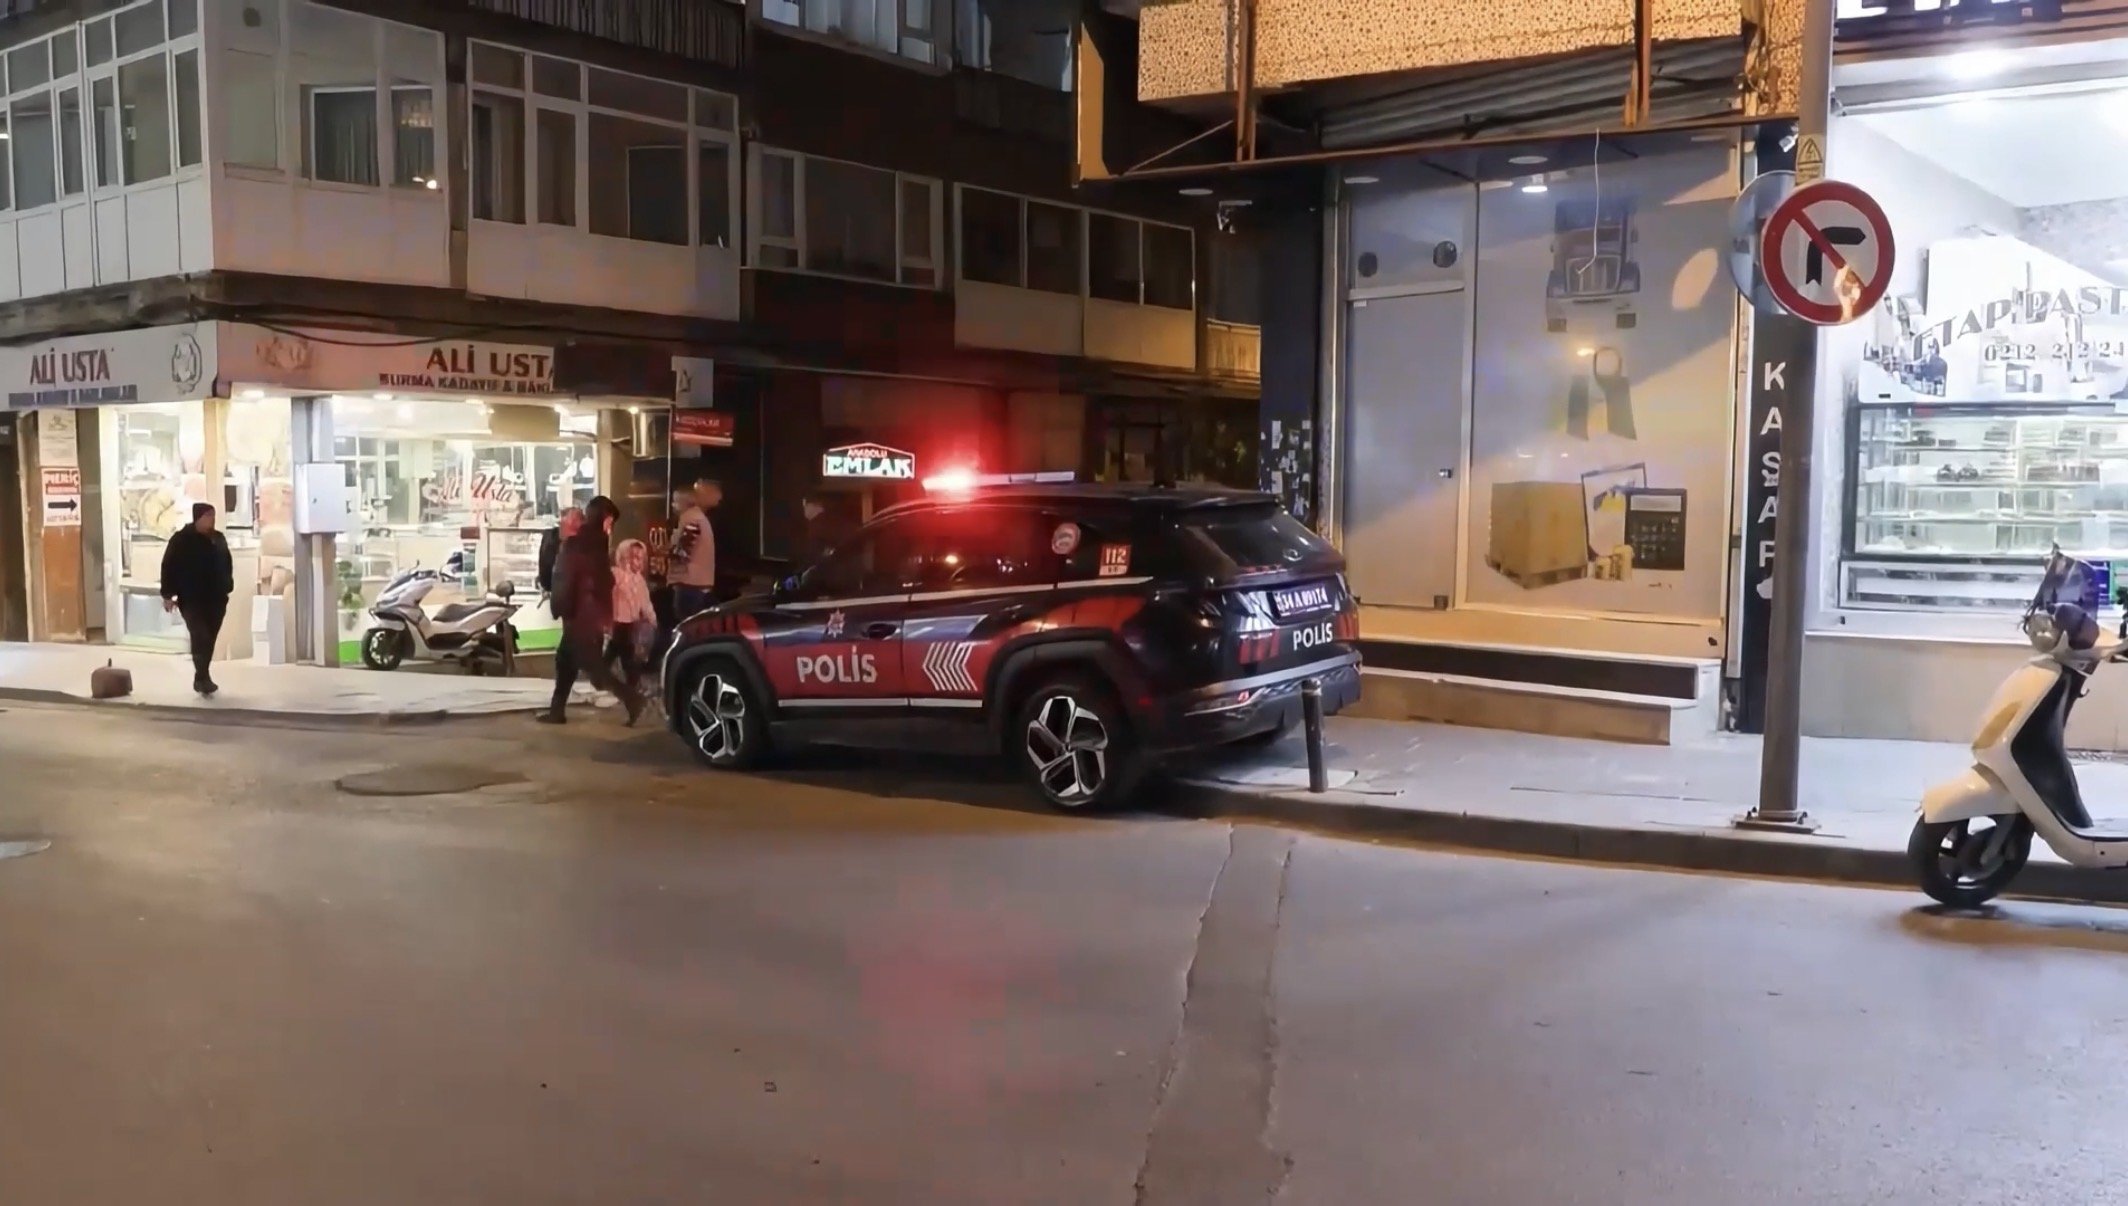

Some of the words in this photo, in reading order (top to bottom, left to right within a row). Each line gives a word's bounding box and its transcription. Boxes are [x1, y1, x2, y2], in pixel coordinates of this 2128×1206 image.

[426, 344, 475, 374] ALİ
[489, 351, 554, 379] UST
[1984, 342, 2036, 361] 0212
[30, 346, 56, 387] ALİ
[62, 348, 110, 383] USTA
[847, 448, 888, 459] ANADOLU
[827, 456, 912, 478] EMLAK
[1105, 548, 1127, 565] 112
[796, 645, 878, 684] POLİS
